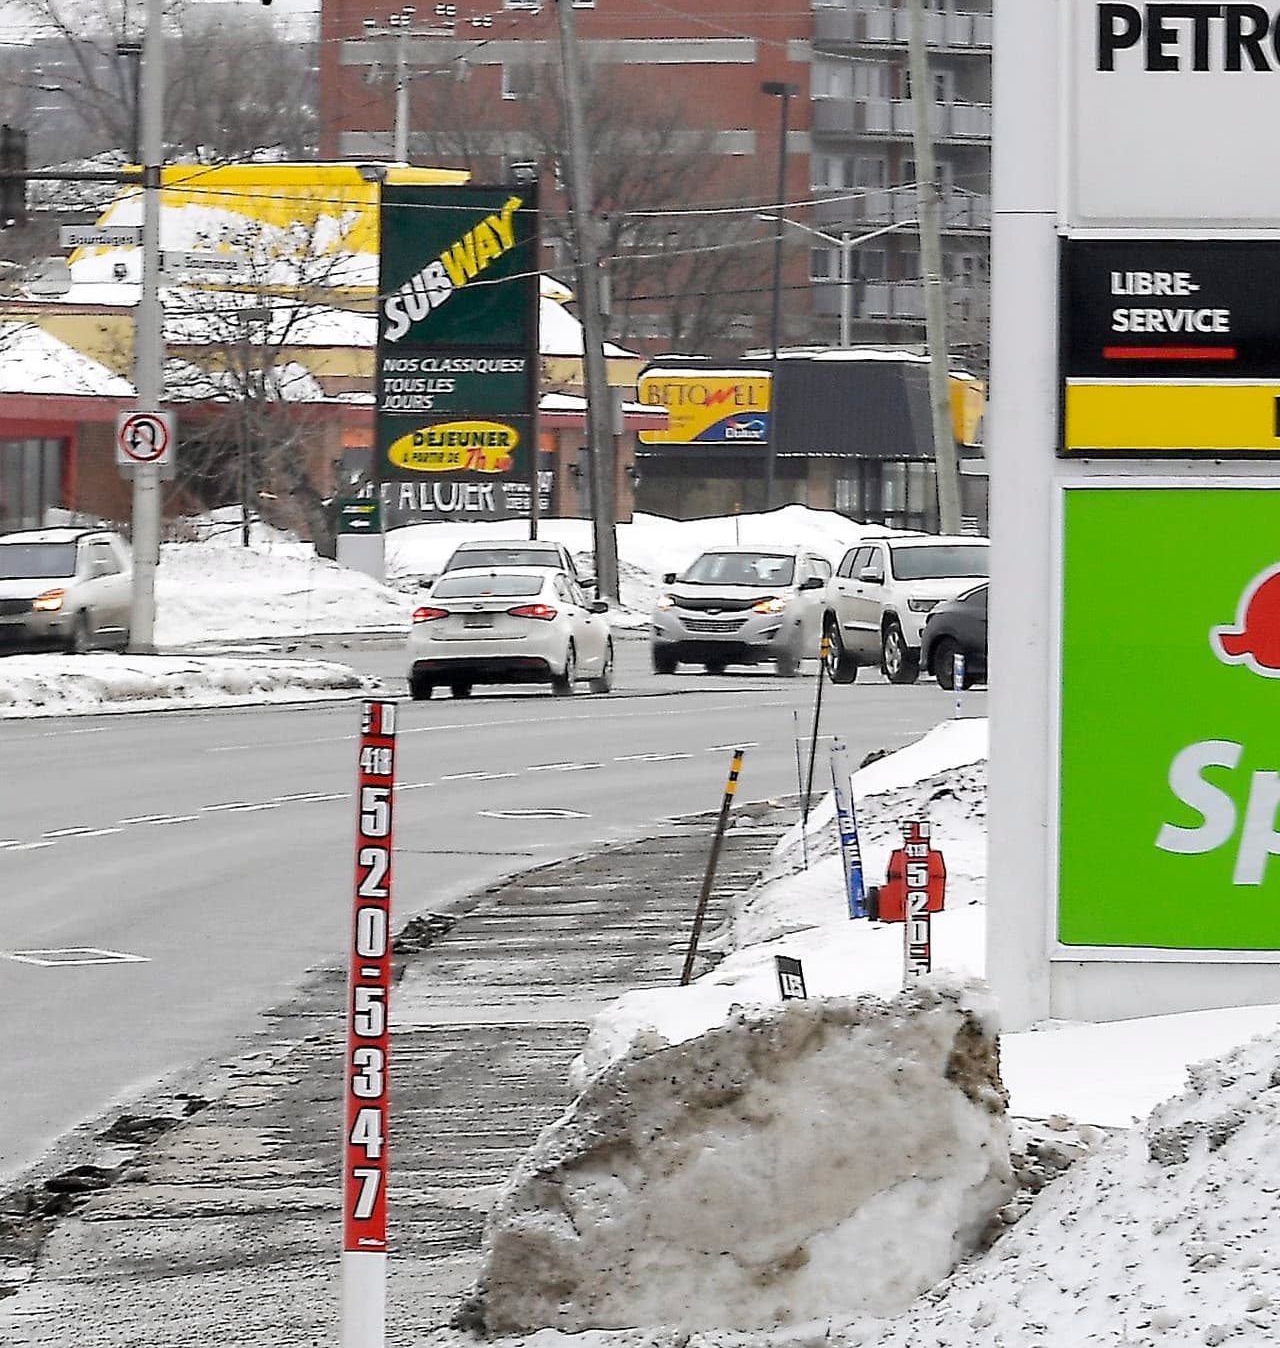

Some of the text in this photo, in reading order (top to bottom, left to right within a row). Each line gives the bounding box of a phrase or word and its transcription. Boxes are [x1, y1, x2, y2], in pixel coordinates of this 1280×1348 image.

[384, 195, 523, 342] SUBWAY
[1110, 272, 1201, 296] LIBRE-
[1110, 308, 1231, 334] SERVICE
[383, 358, 418, 372] NOS
[383, 378, 455, 393] TOUS LES
[381, 395, 434, 409] JOURS
